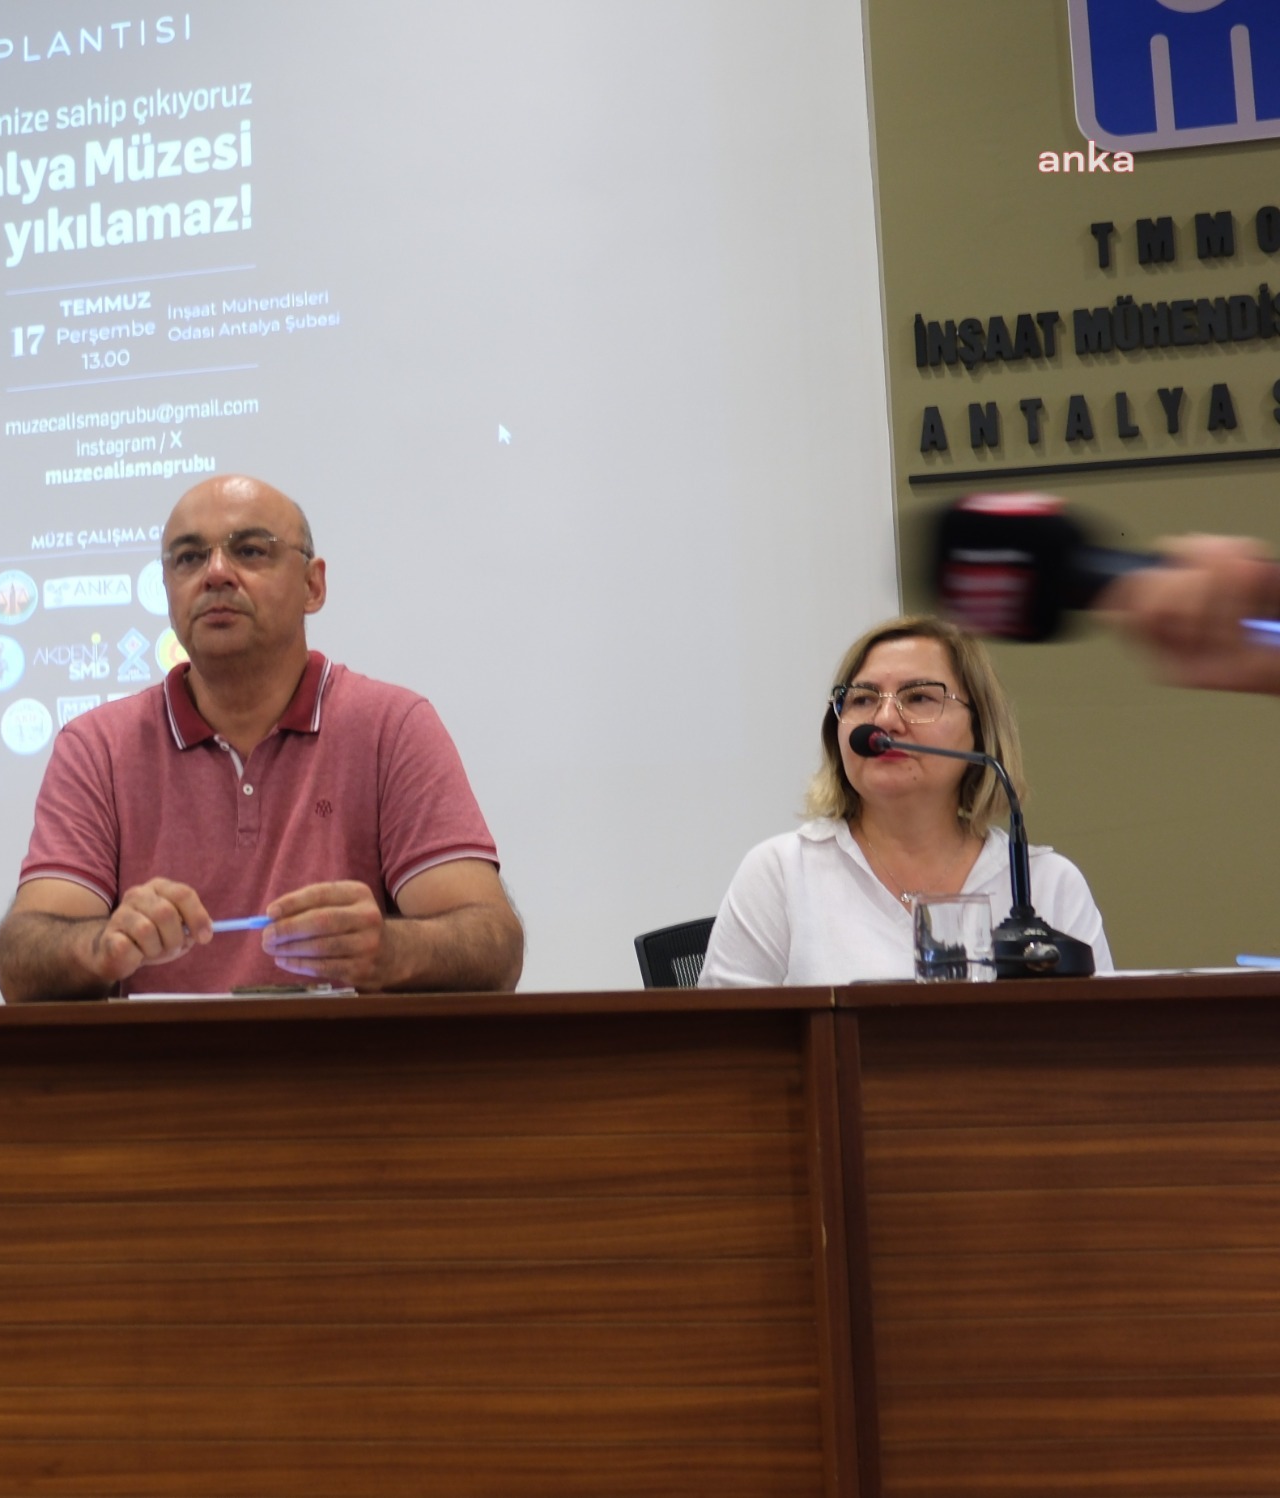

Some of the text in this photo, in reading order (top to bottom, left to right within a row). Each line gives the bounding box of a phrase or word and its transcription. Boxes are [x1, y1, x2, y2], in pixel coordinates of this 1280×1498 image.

[56, 95, 127, 131] sahip
[133, 82, 253, 125] çıkıyoruz
[85, 119, 253, 188] Müzesi
[4, 183, 253, 268] yıkılamaz!
[59, 291, 152, 318] TEMMUZ
[11, 319, 156, 358] 17 Perşembe
[219, 318, 280, 337] Antalya
[914, 313, 1060, 370] İNŞAAT
[81, 349, 130, 371] 13.00
[5, 397, 260, 436] muzecalismagrubu@gmail.com
[920, 382, 1238, 452] ANTALYA
[76, 430, 183, 458] instagram / X
[45, 454, 216, 486] muzecalismagrubu
[77, 526, 146, 549] ÇALIŞMA
[73, 579, 129, 596] ANKA
[69, 660, 110, 681] SMD
